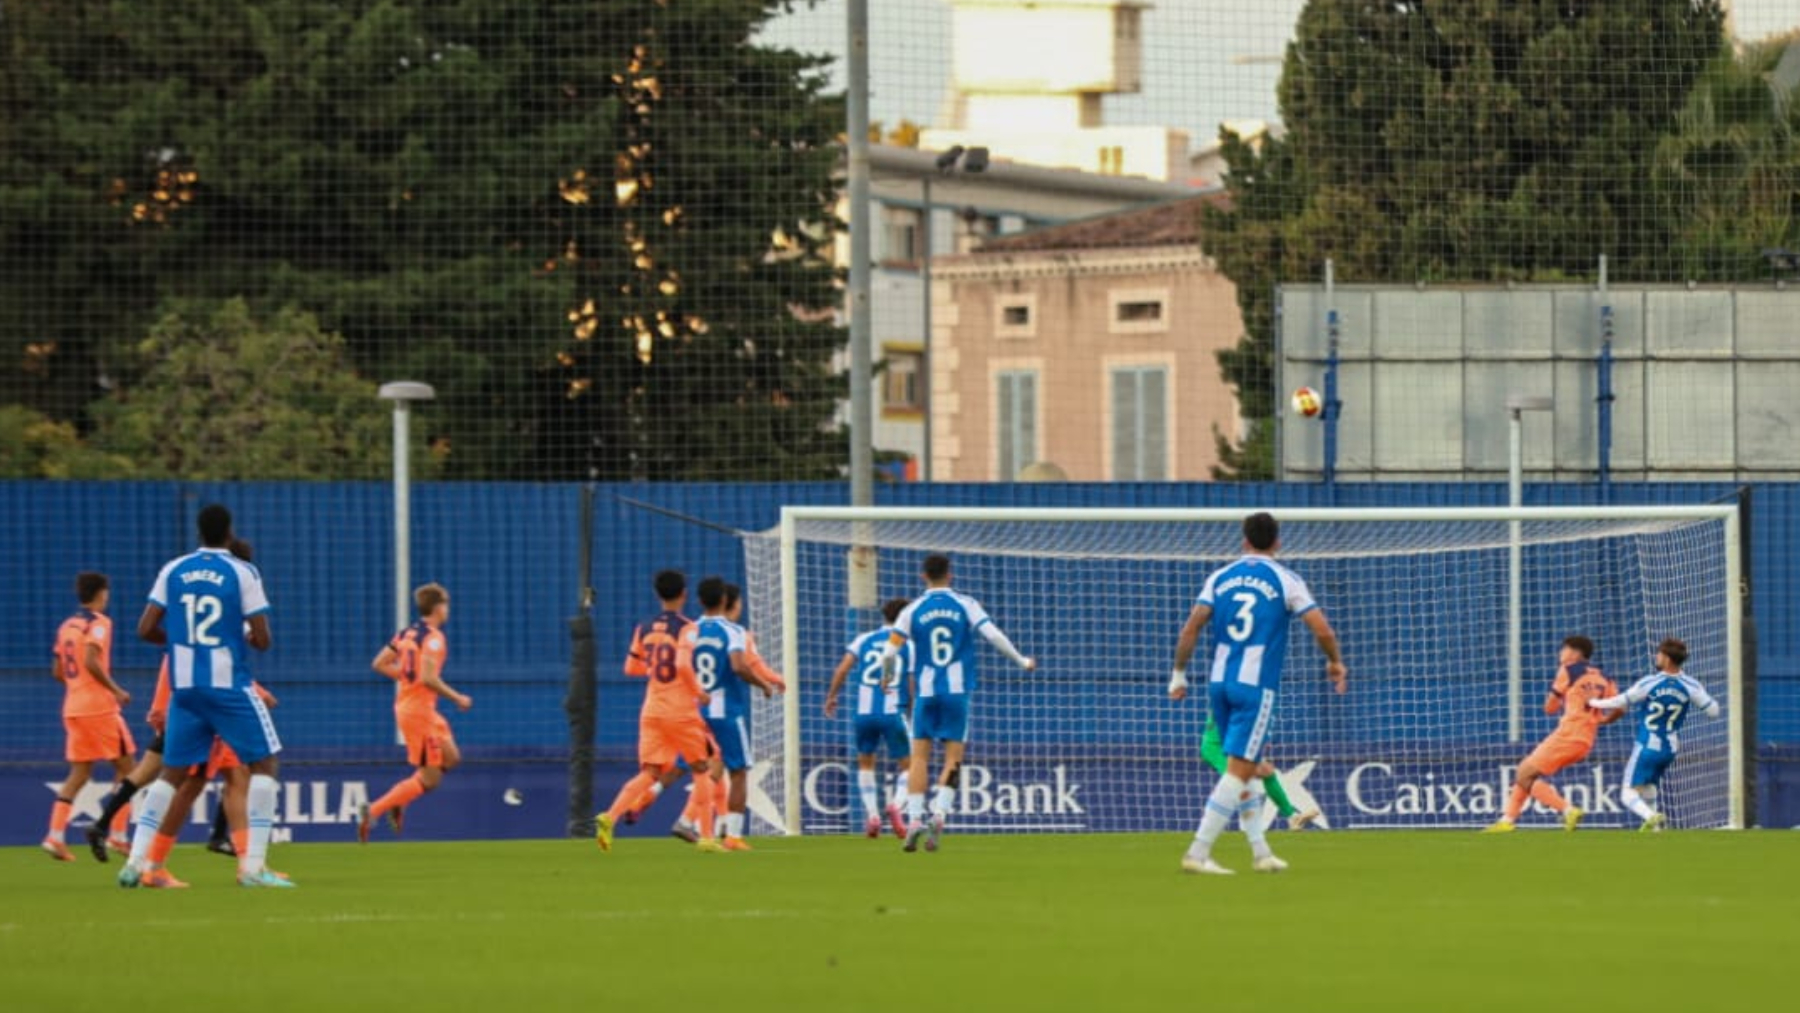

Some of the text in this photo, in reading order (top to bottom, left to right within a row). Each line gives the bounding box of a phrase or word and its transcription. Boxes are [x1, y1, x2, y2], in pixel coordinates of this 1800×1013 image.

[181, 593, 222, 645] 12
[1227, 592, 1256, 641] 3
[930, 626, 952, 666] 6
[696, 652, 716, 690] 8
[1645, 702, 1683, 731] 27
